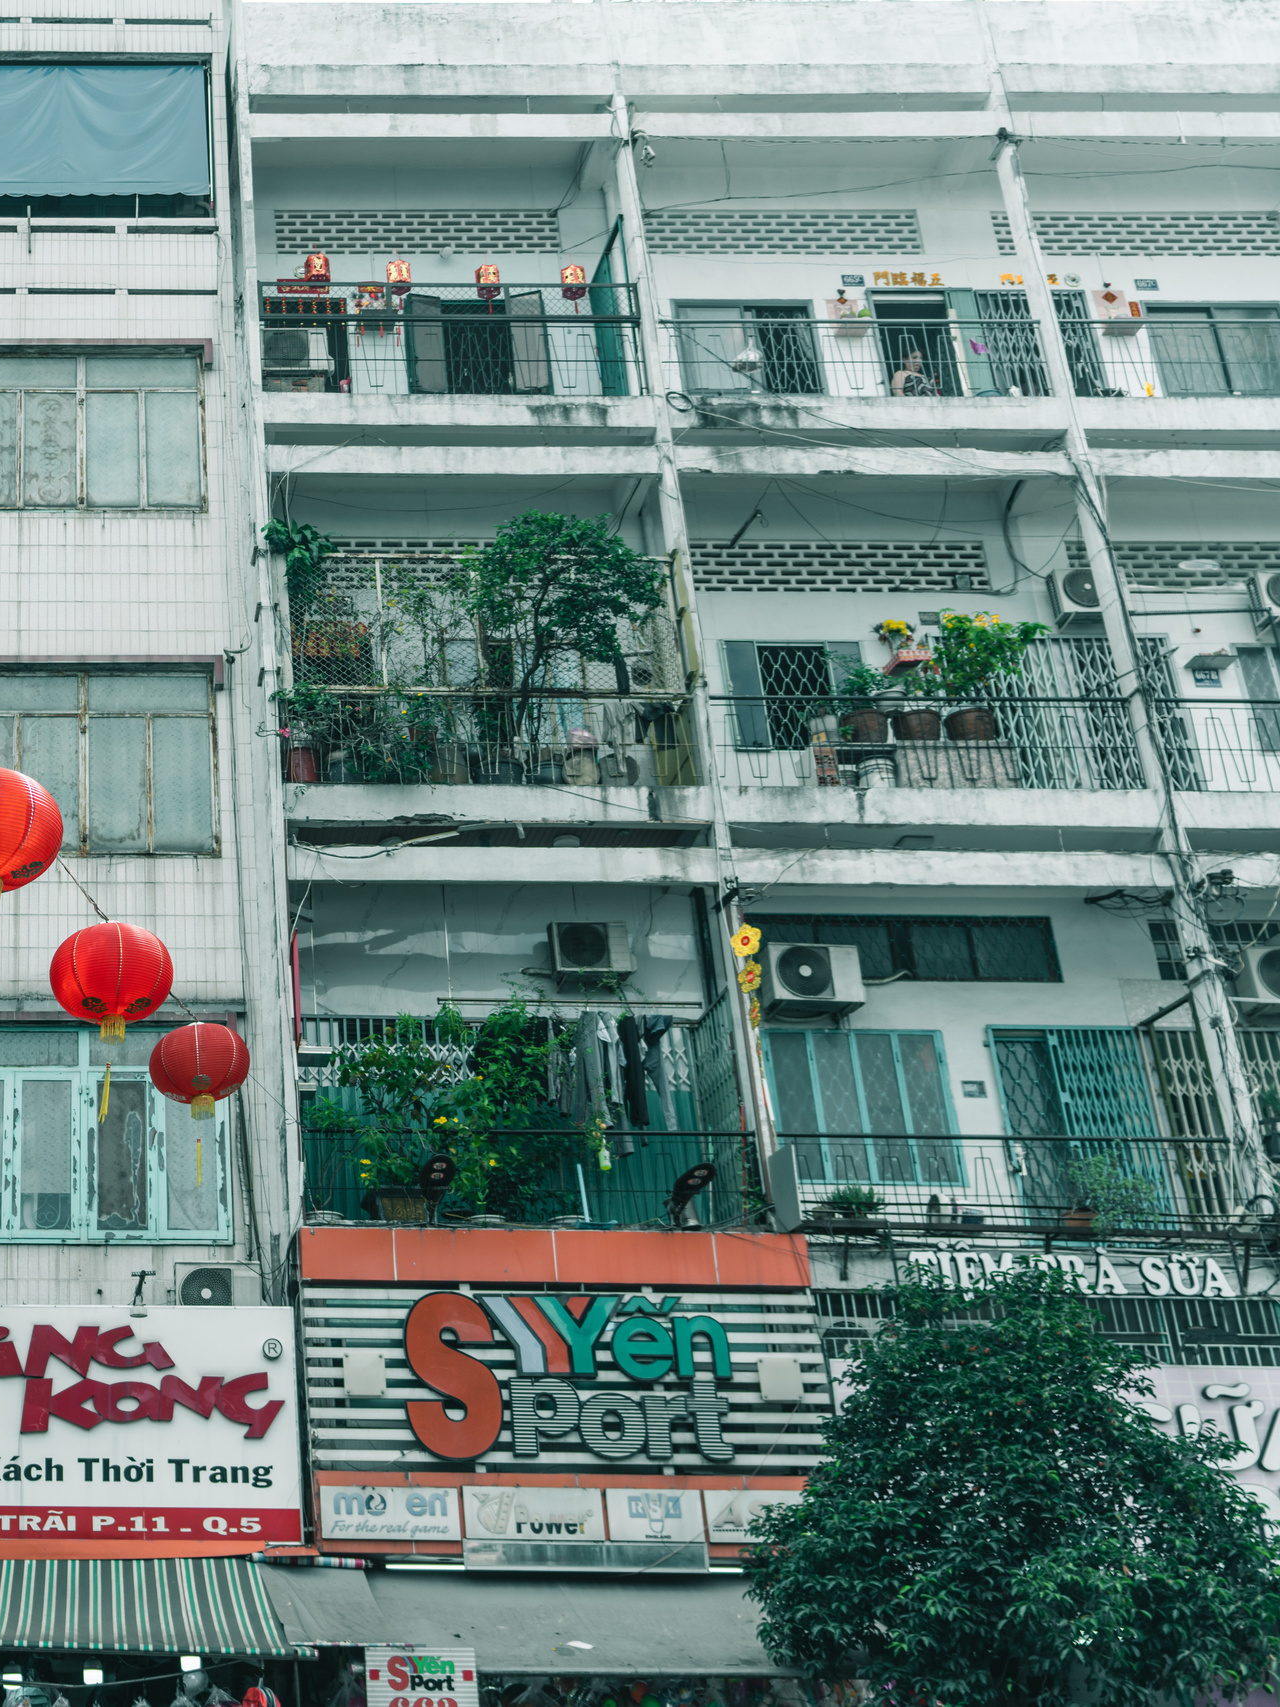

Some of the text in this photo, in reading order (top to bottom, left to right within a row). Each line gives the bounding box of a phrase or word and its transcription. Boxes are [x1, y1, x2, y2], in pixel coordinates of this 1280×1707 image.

[1140, 1253, 1236, 1298] SỮA
[77, 1456, 154, 1482] Thời
[168, 1458, 273, 1487] Trang
[91, 1514, 166, 1533] P.11
[203, 1515, 262, 1534] Q.5
[330, 1520, 450, 1538] For the real game
